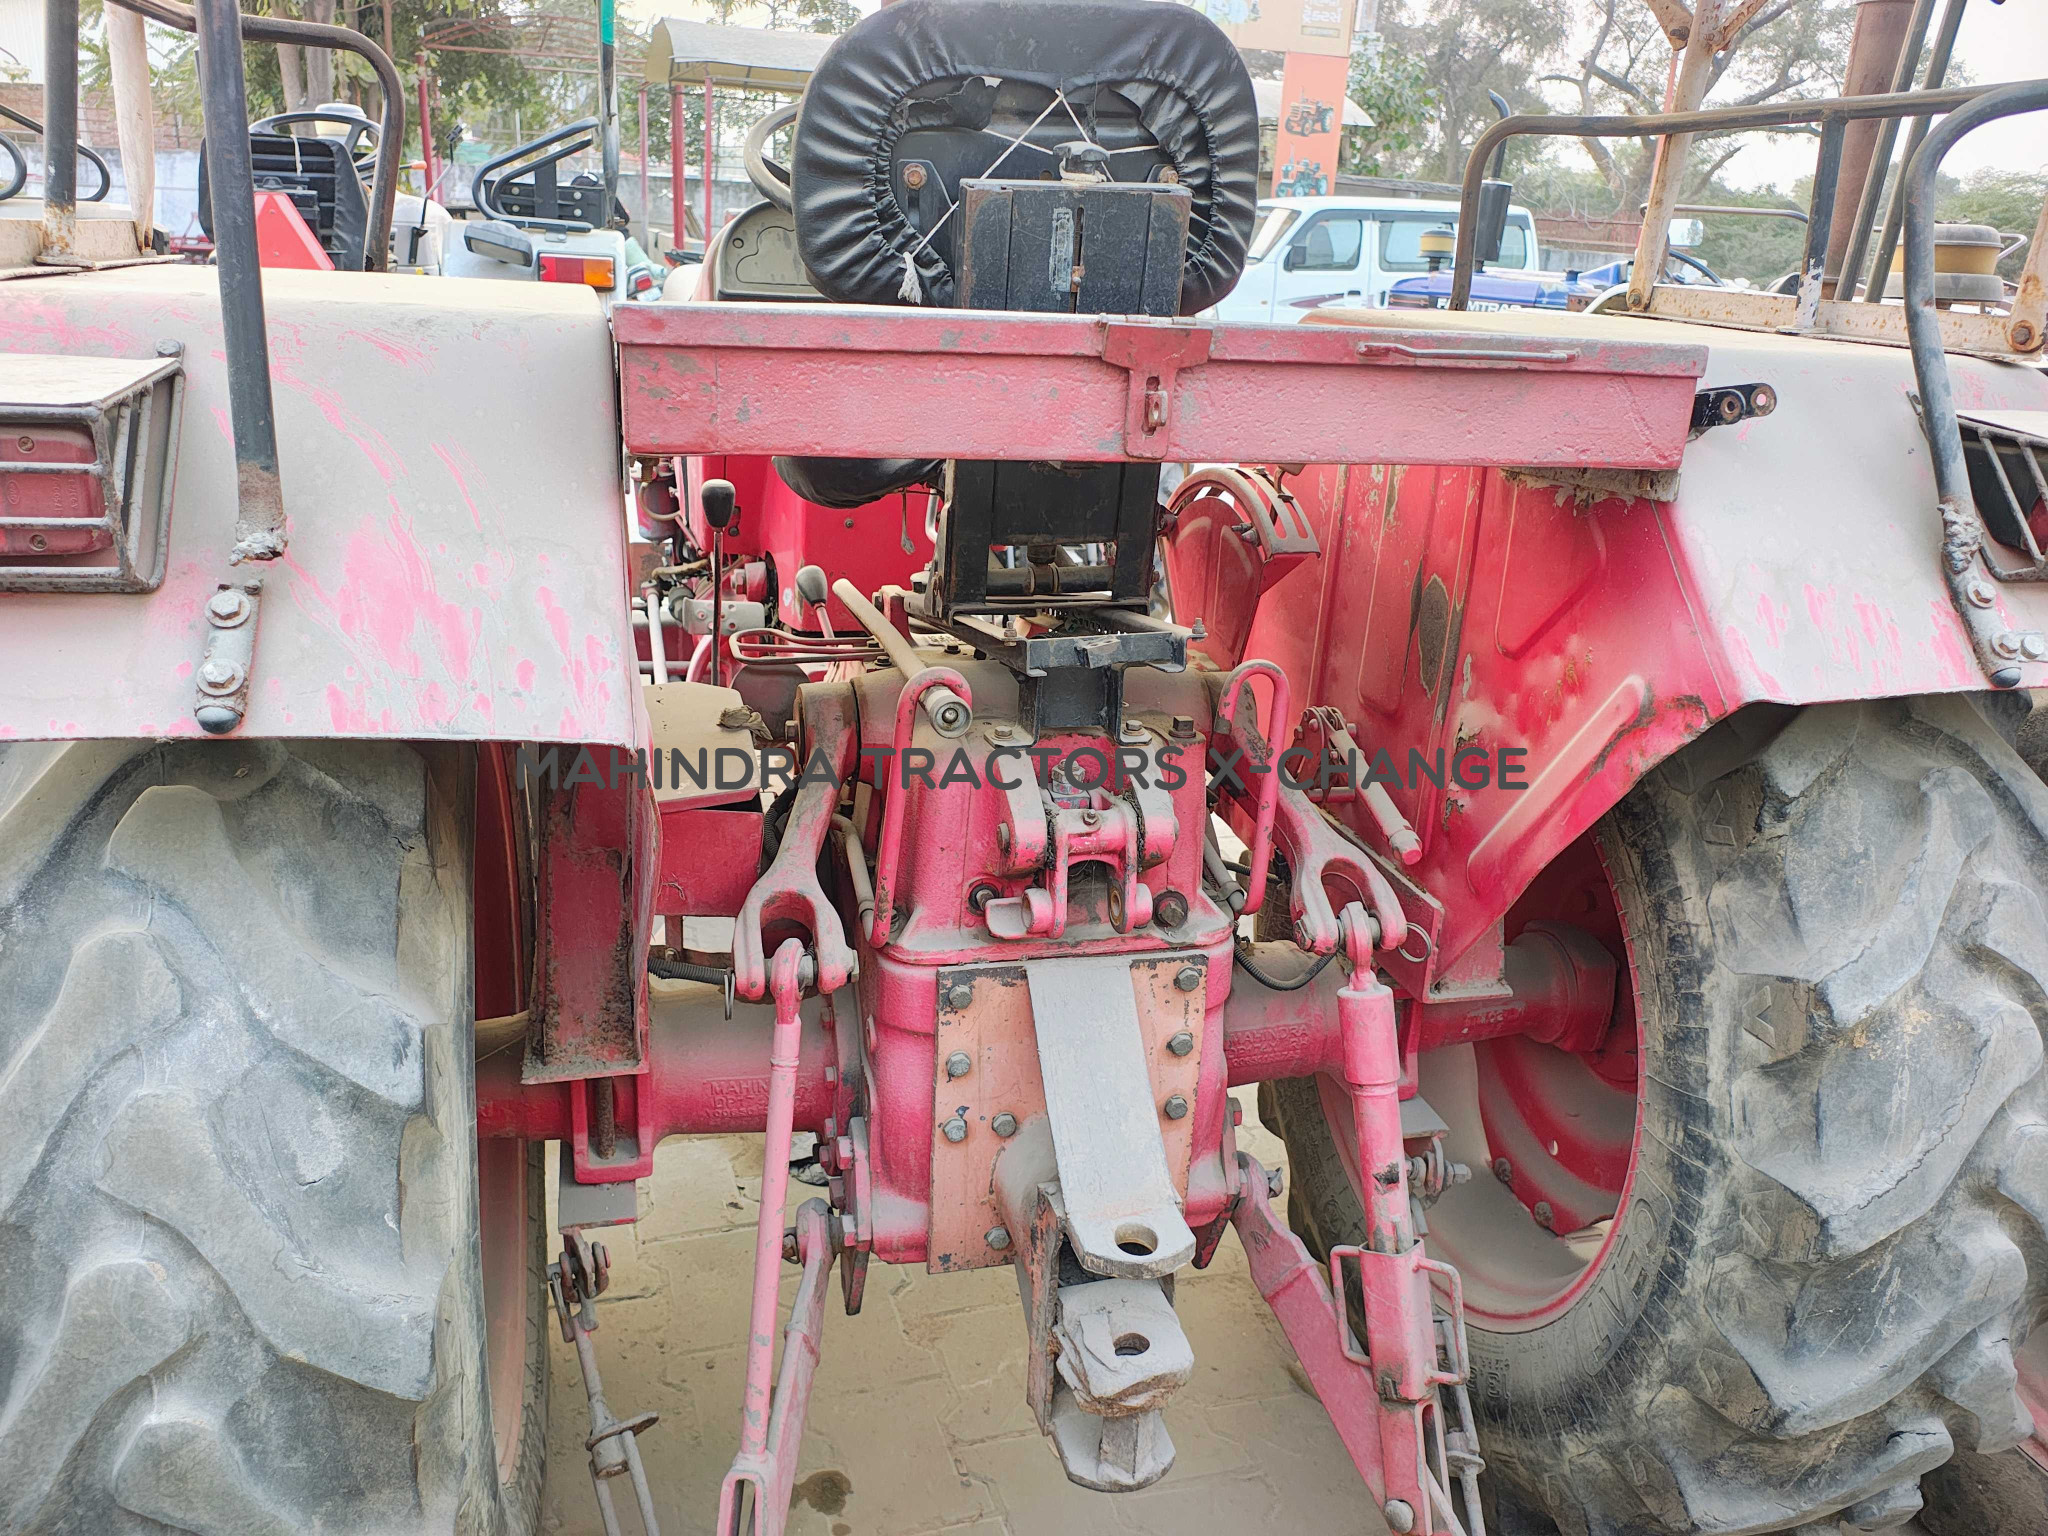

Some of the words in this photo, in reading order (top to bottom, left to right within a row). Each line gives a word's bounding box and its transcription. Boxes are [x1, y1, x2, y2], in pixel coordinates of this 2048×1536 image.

[1436, 297, 1521, 312] FMTRA
[1230, 1025, 1308, 1044] MAHINDRA
[1588, 1197, 1660, 1363] CEAT
